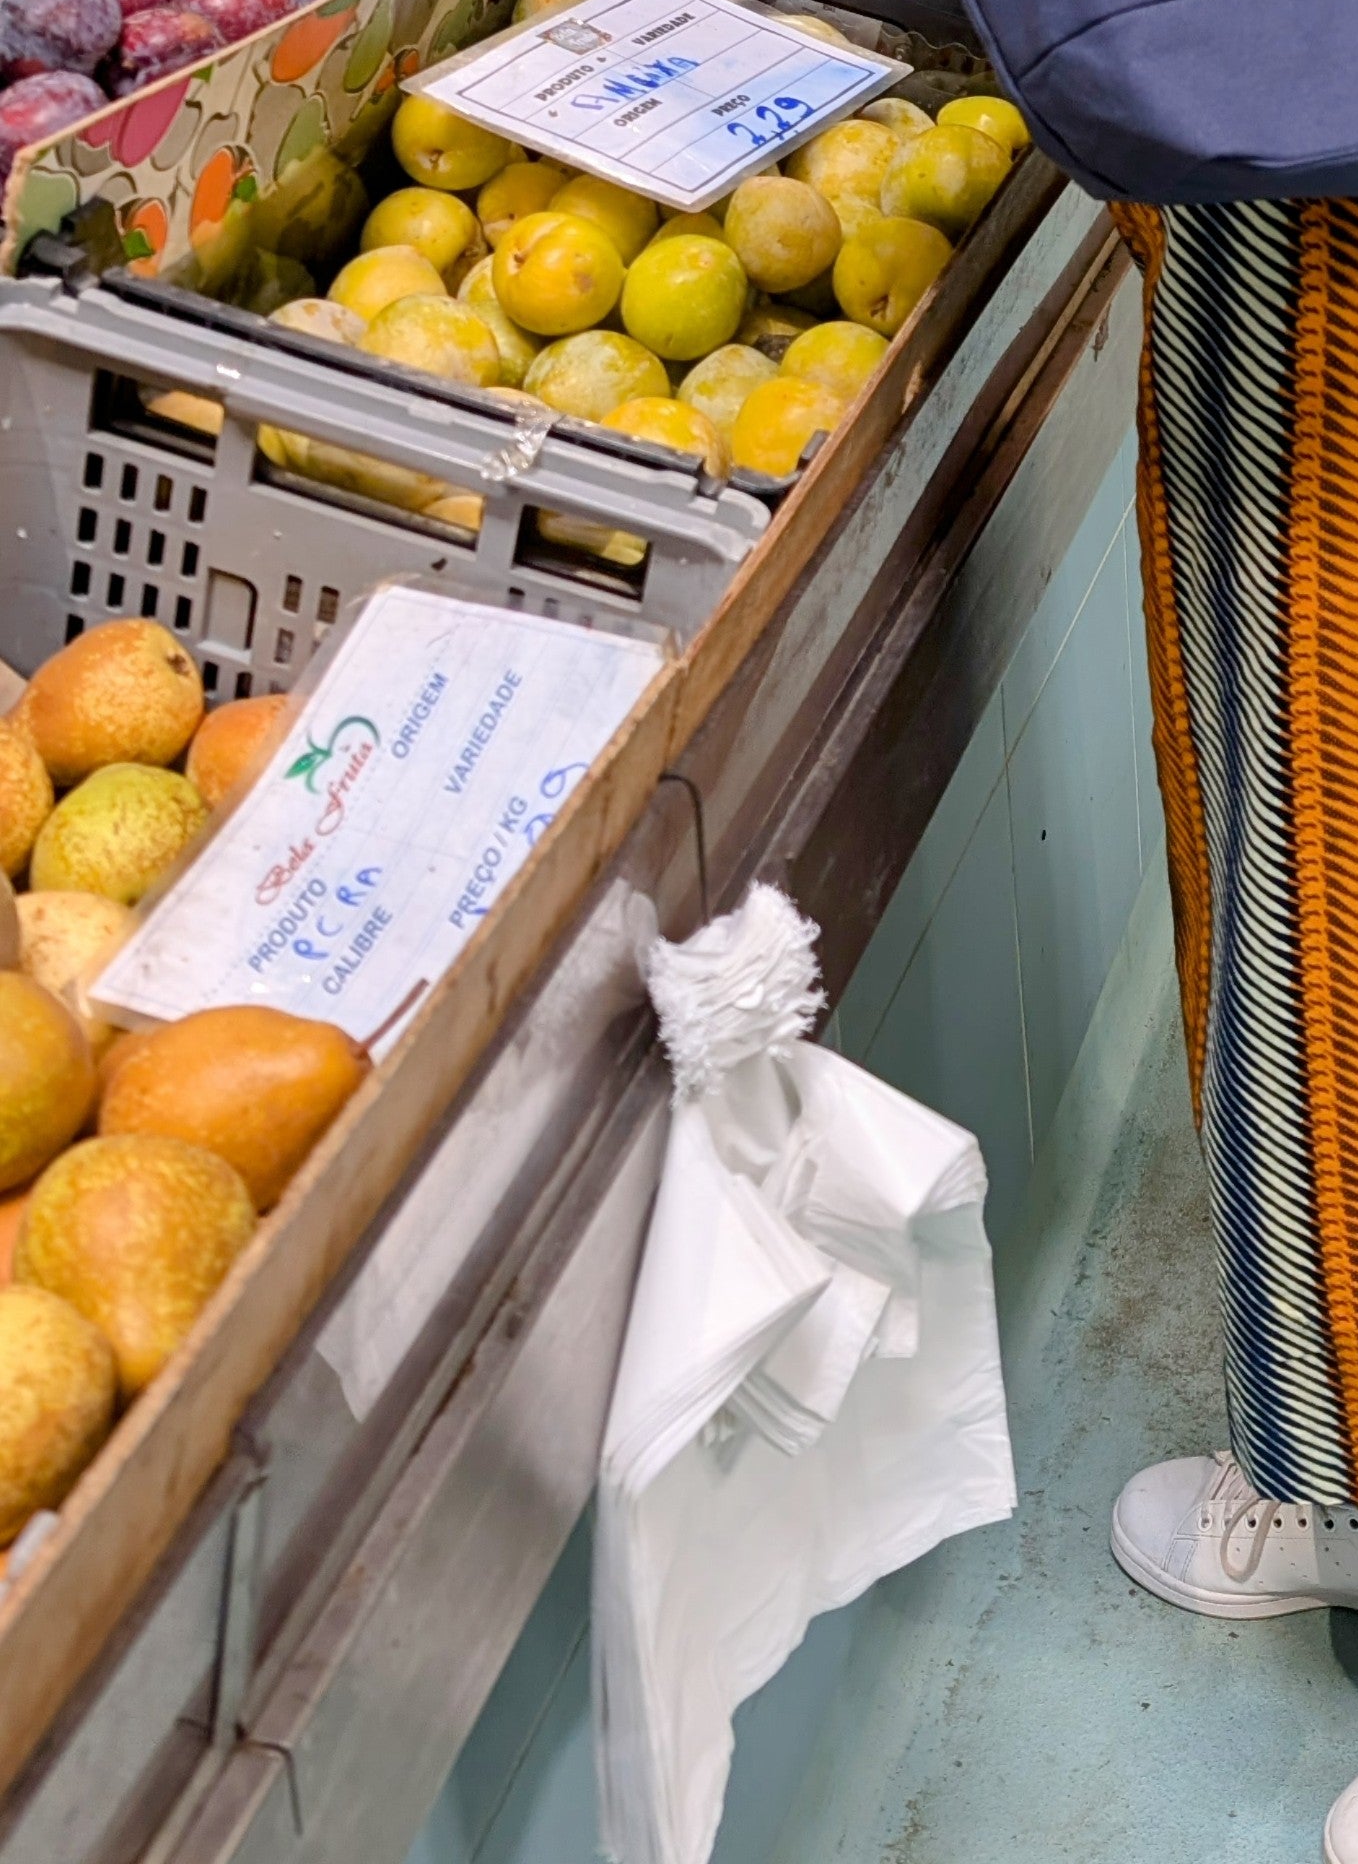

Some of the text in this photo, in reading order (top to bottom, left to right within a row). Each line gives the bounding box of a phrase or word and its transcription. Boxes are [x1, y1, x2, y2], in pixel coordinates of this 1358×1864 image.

[536, 11, 696, 102] PRODUTO VARIEDADE
[612, 97, 660, 128] ORIGEM
[711, 93, 751, 117] PREÇO
[248, 671, 450, 974] PRODUTO ORIGEM
[321, 668, 524, 996] CALIBRE VARIEDADE
[448, 846, 502, 929] PREÇO
[500, 795, 529, 834] KG
[254, 838, 316, 907] Bela
